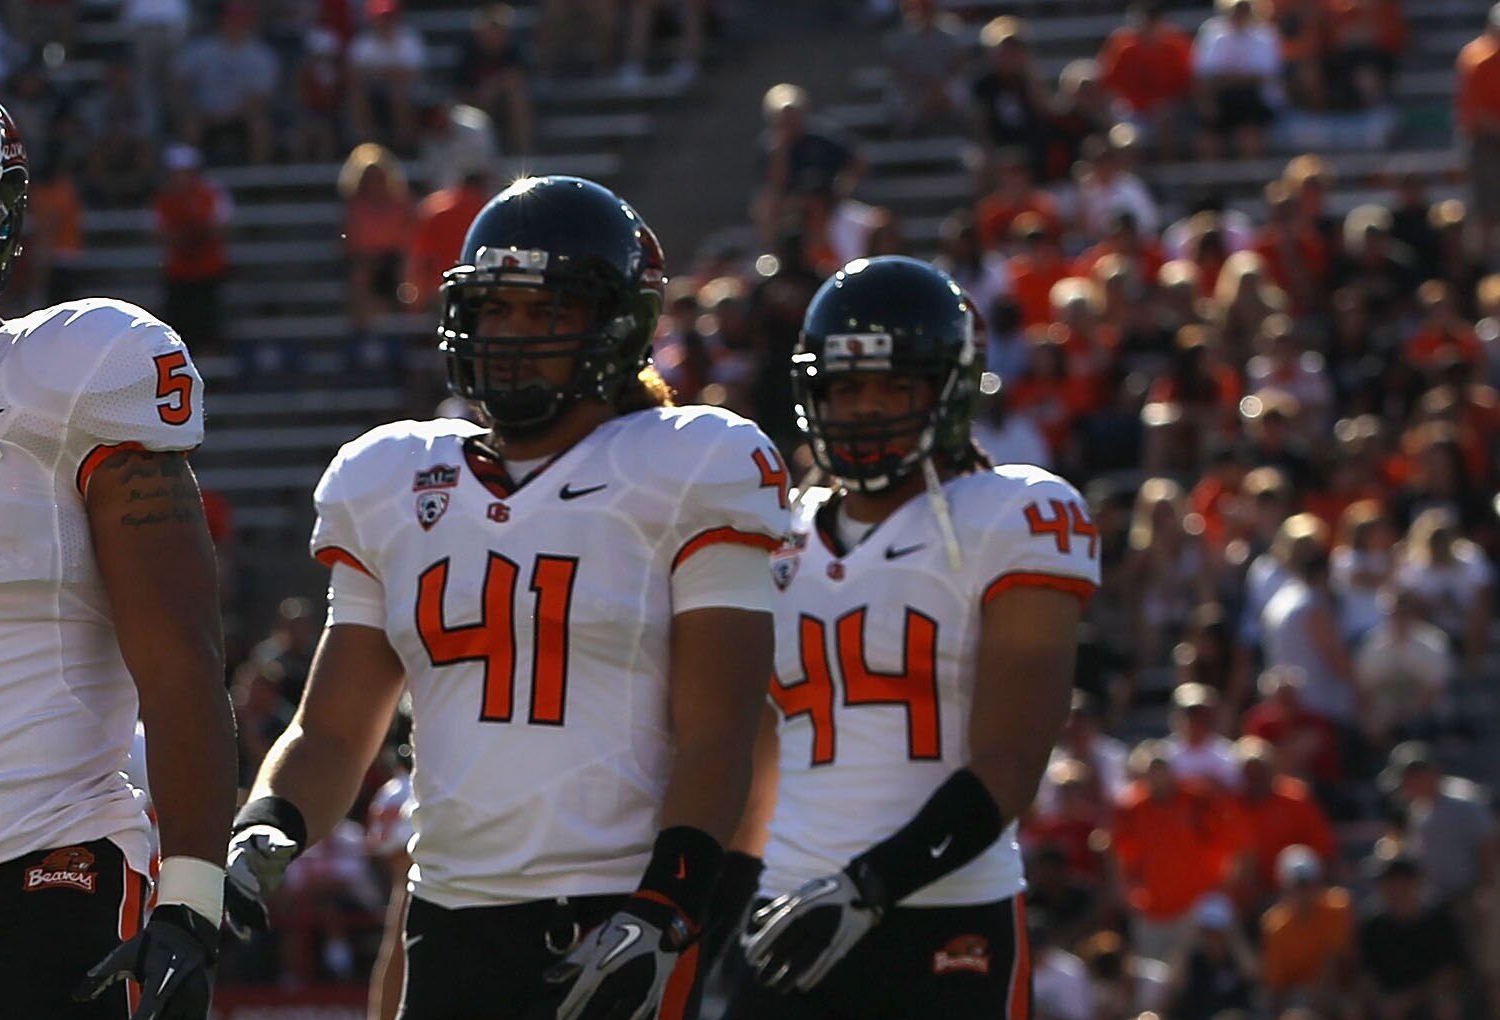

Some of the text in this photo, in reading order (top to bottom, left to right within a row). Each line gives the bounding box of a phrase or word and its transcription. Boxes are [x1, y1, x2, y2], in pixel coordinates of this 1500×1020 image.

[152, 350, 193, 425] 5
[1022, 498, 1099, 560] 44
[415, 549, 580, 727] 41
[768, 602, 943, 769] 44
[28, 868, 92, 890] Beavers
